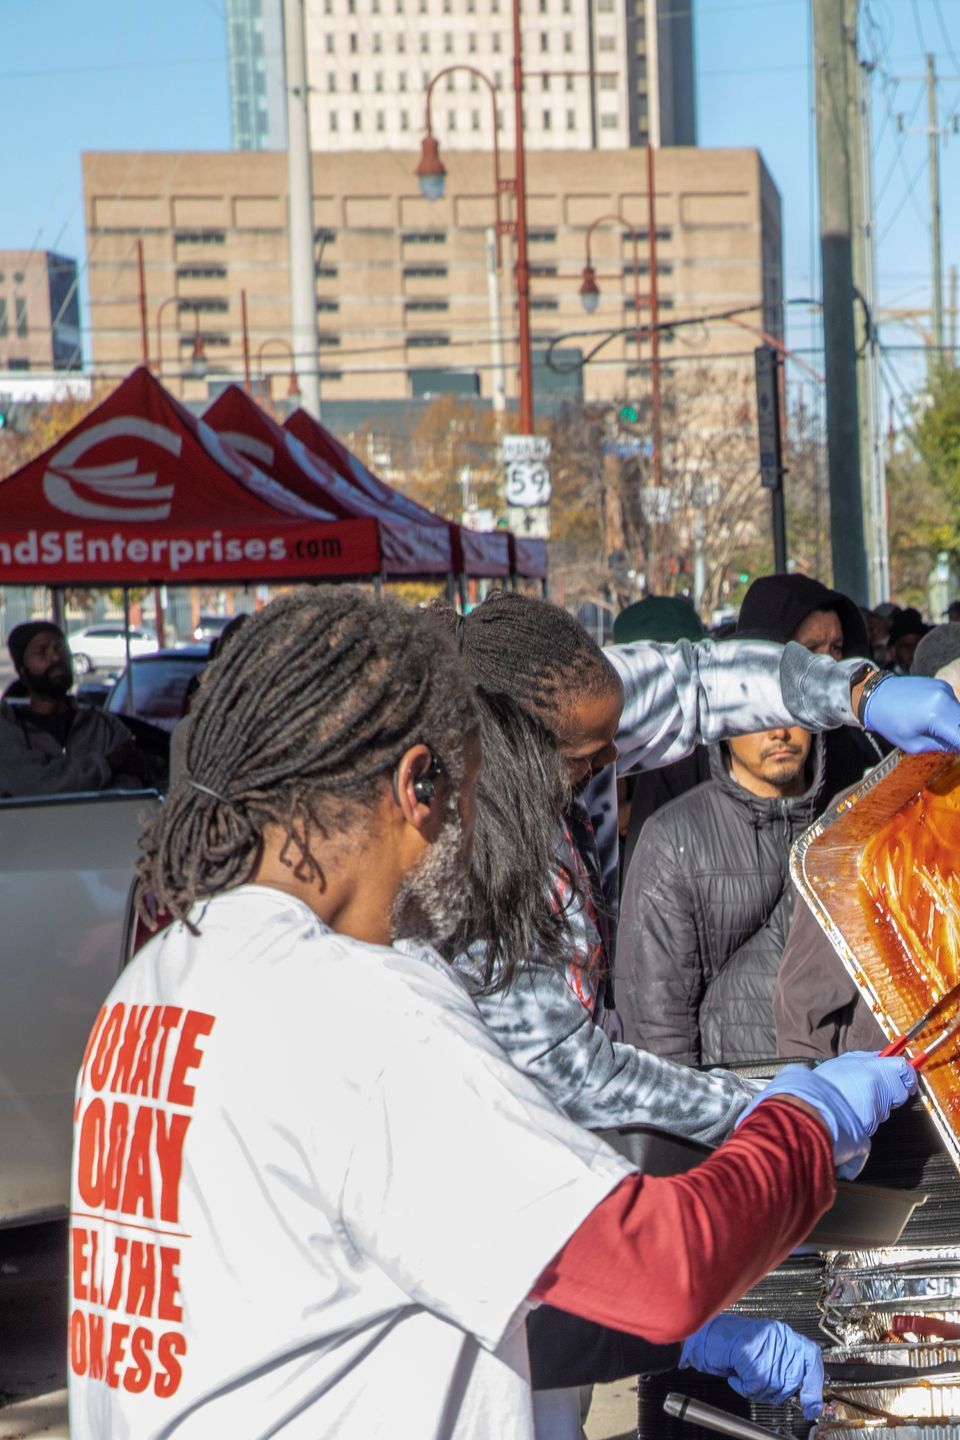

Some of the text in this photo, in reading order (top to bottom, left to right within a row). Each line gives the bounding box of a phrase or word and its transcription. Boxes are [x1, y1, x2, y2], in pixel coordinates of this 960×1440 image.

[512, 470, 545, 495] 59
[74, 1097, 193, 1223] ODAY
[107, 1236, 184, 1322] THE
